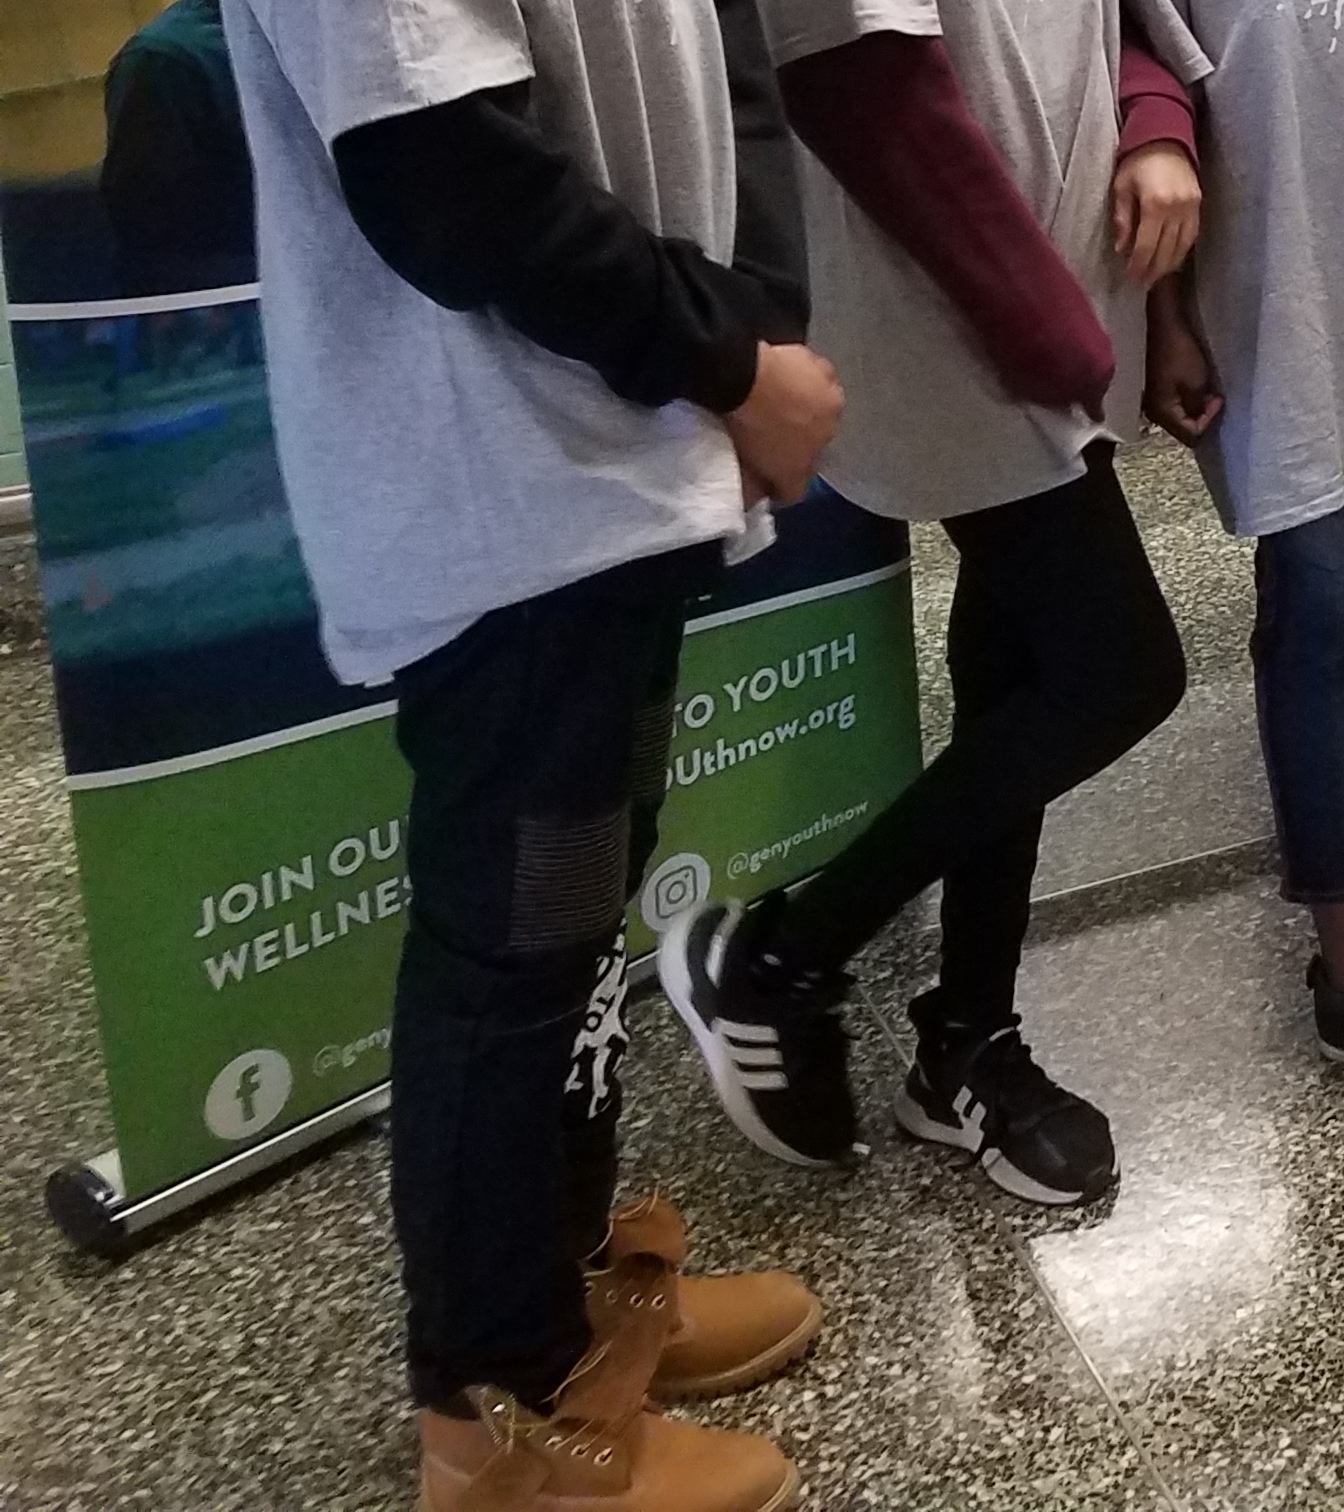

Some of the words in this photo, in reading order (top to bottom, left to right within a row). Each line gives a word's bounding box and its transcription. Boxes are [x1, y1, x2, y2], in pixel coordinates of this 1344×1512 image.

[722, 632, 856, 712] YOUTH
[193, 854, 315, 938] JOIN
[328, 817, 406, 877] OU
[727, 800, 869, 880] @genyouthnow
